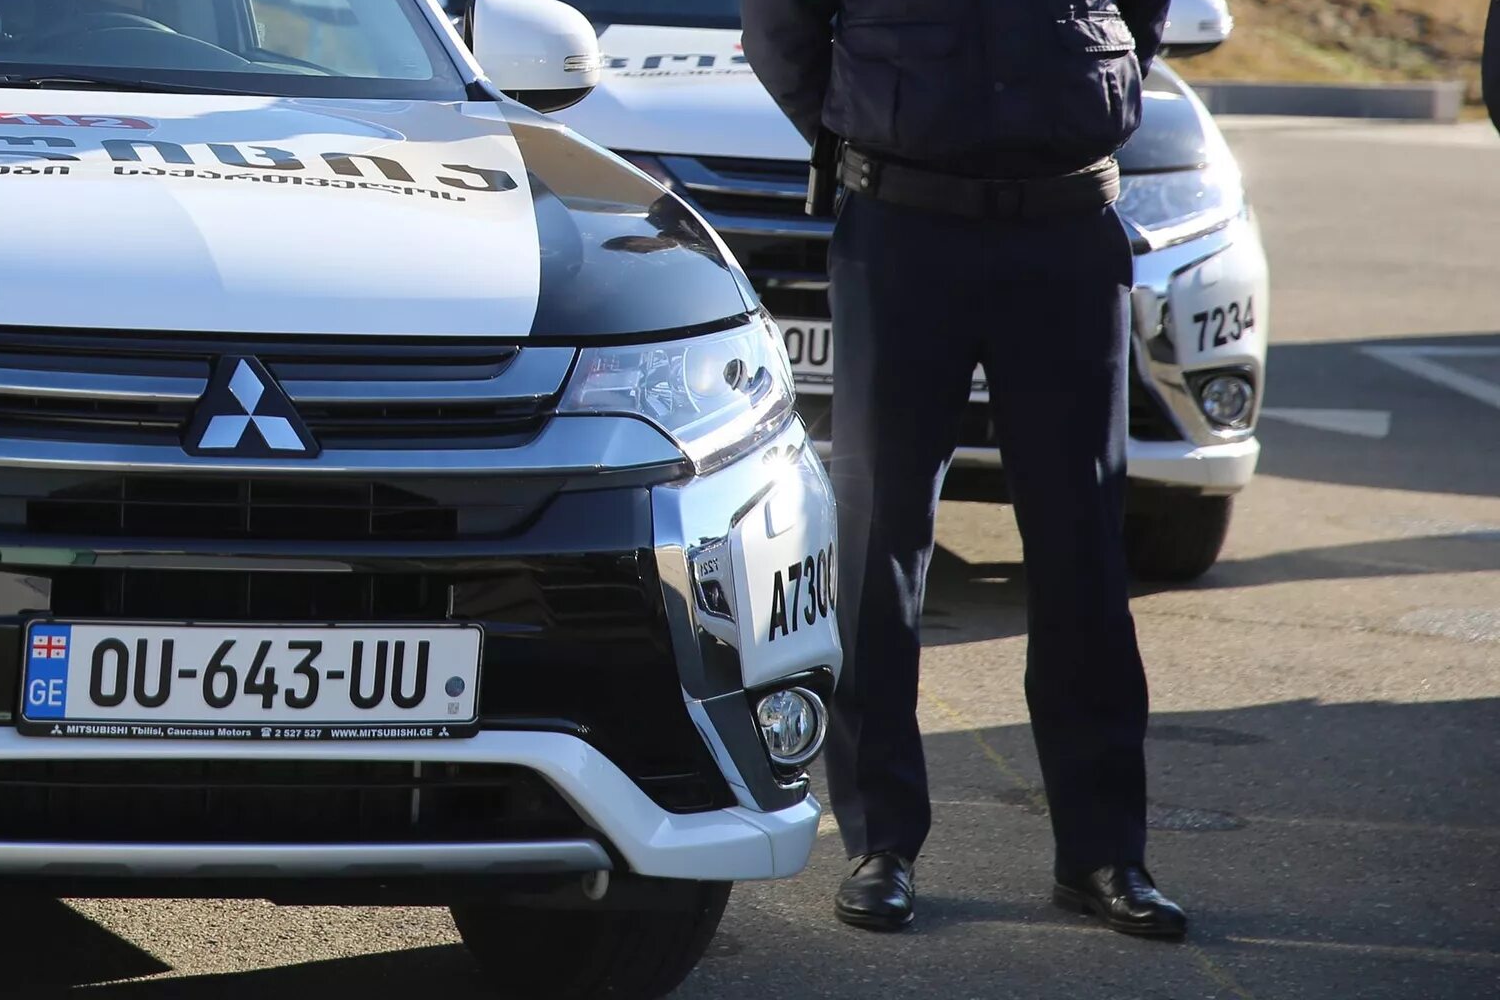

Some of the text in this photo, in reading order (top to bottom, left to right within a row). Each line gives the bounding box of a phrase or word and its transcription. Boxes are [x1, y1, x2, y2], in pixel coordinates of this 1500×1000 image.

[0, 113, 133, 128] 112
[113, 166, 466, 203] საქართველოს
[1193, 295, 1256, 353] 7234
[89, 637, 430, 710] OU-643-UU
[29, 678, 63, 706] GE
[66, 725, 434, 738] MITSUBISHI Tbilisi, Caucasus Motors 2 527 527 WWW.MITSUBISHI.GE
